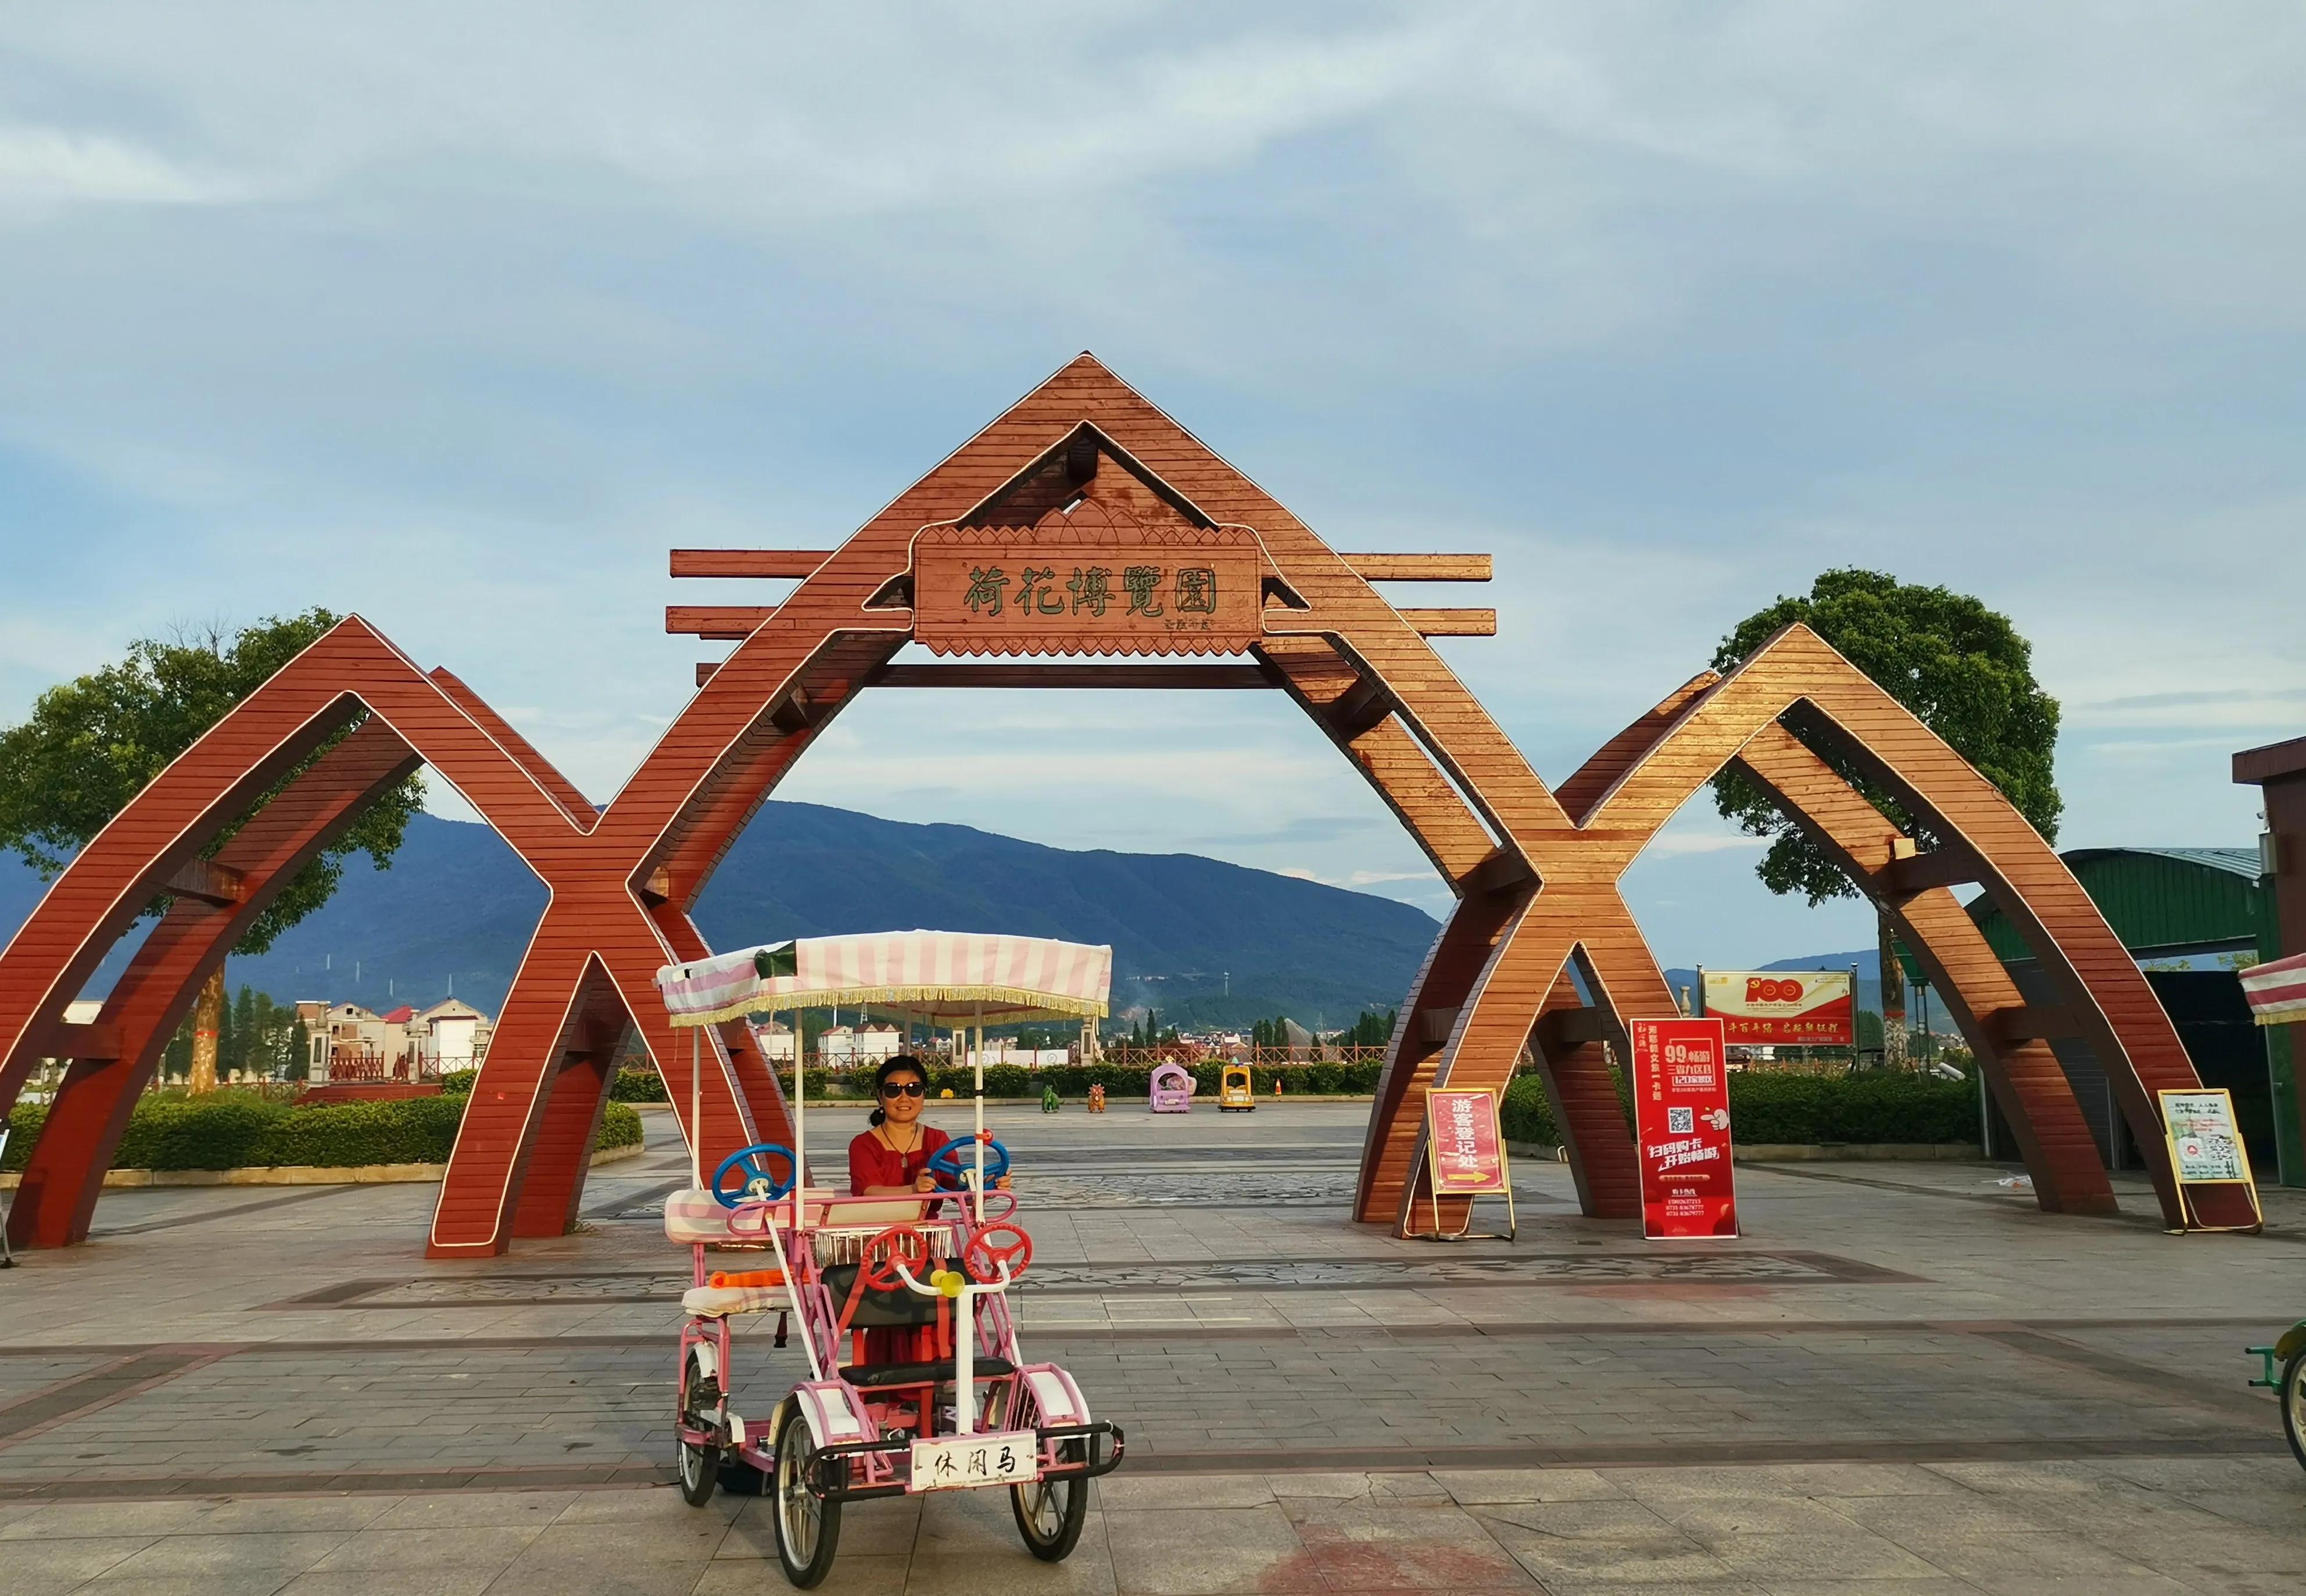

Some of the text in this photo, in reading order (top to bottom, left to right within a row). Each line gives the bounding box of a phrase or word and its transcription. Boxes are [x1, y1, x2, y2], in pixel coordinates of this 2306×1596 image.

[963, 565, 1217, 618] 荷花博覽園
[1745, 977, 1804, 1002] 100
[1724, 1022, 1773, 1034] 斗百年路
[1451, 1099, 1479, 1168] 游客登记处
[934, 1446, 1016, 1478] 休闲马
